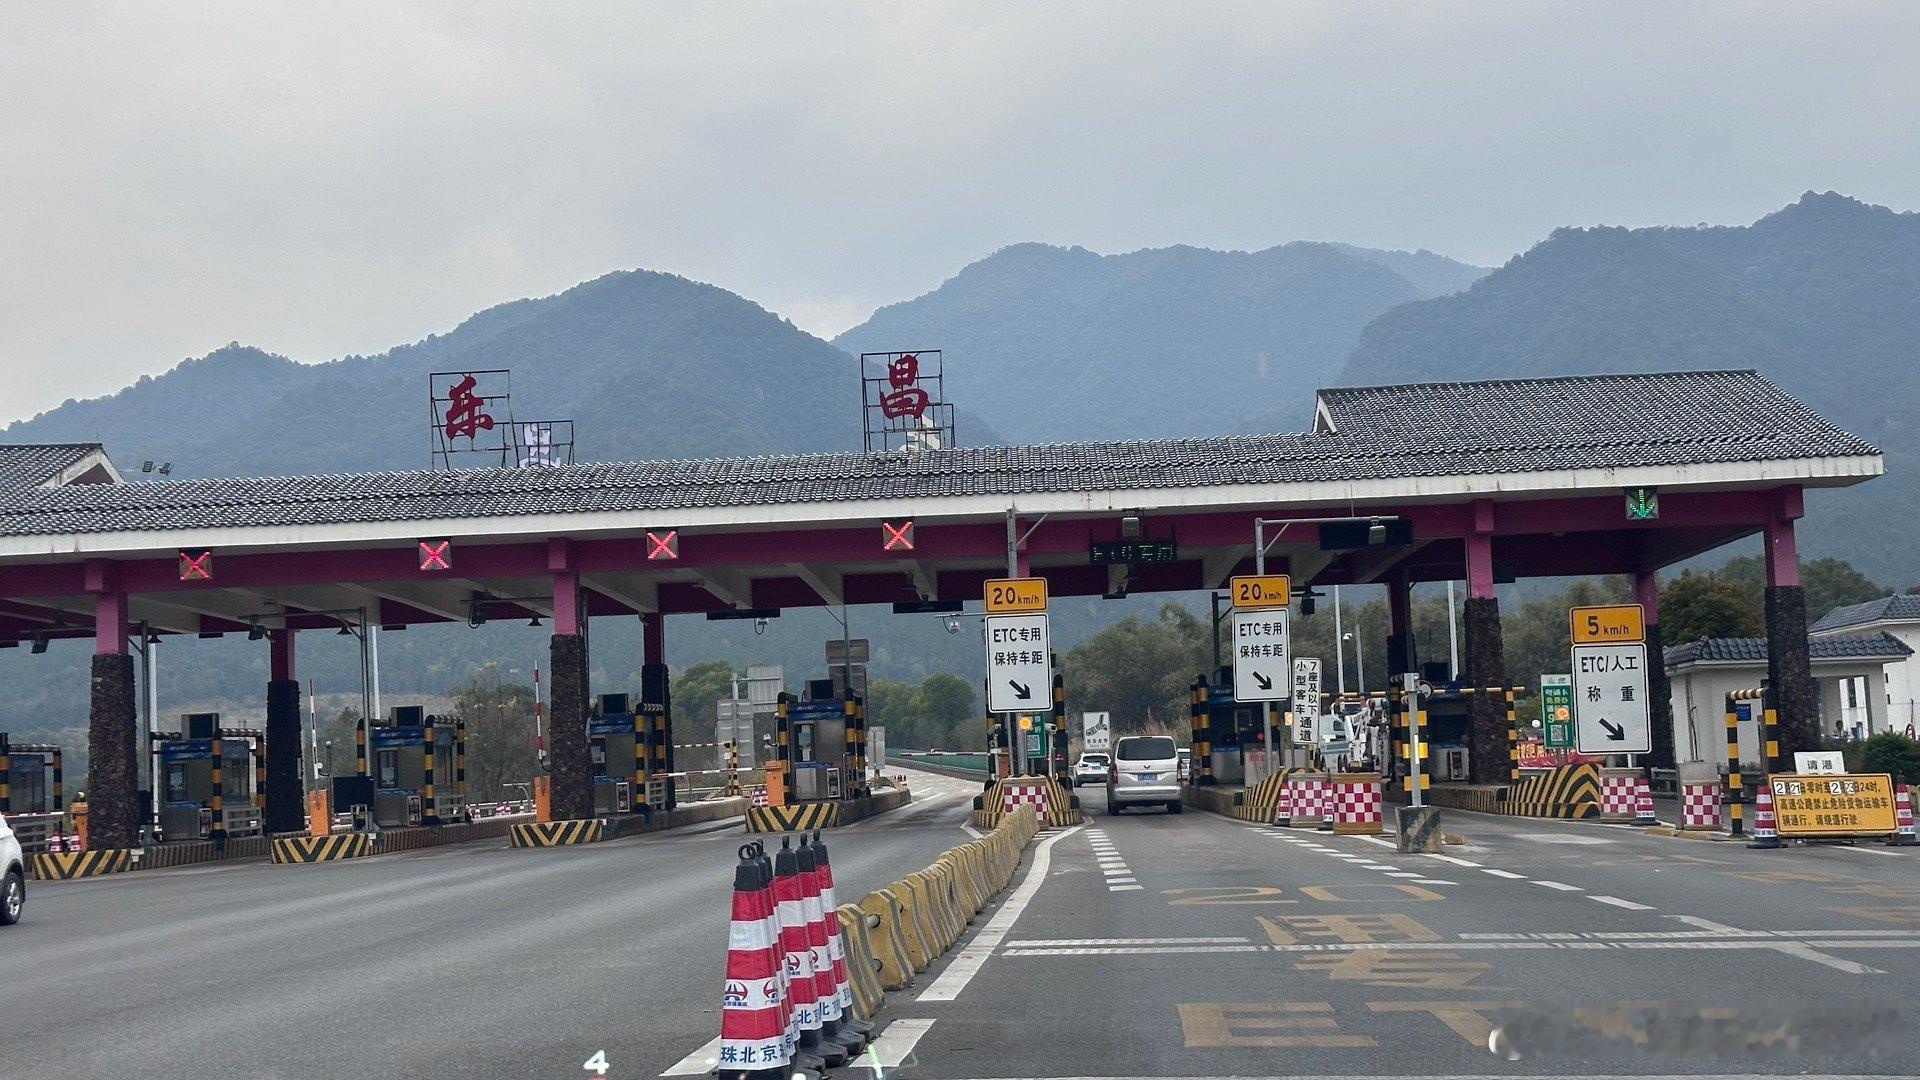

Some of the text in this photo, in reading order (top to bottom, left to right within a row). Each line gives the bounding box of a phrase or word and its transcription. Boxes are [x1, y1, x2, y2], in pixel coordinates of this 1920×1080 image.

[446, 355, 928, 439] 乐 昌
[1240, 583, 1261, 600] 20
[993, 627, 1041, 642] ETC专用
[1239, 622, 1282, 637] ETC专用
[1588, 616, 1629, 636] 5 km/h
[994, 650, 1043, 666] 保持车距
[1240, 643, 1283, 658] 保持车距
[1581, 655, 1638, 672] ETC/人工
[1295, 661, 1306, 714] 小型客车
[1307, 661, 1318, 715] 7座及以下
[1299, 716, 1312, 741] 通道
